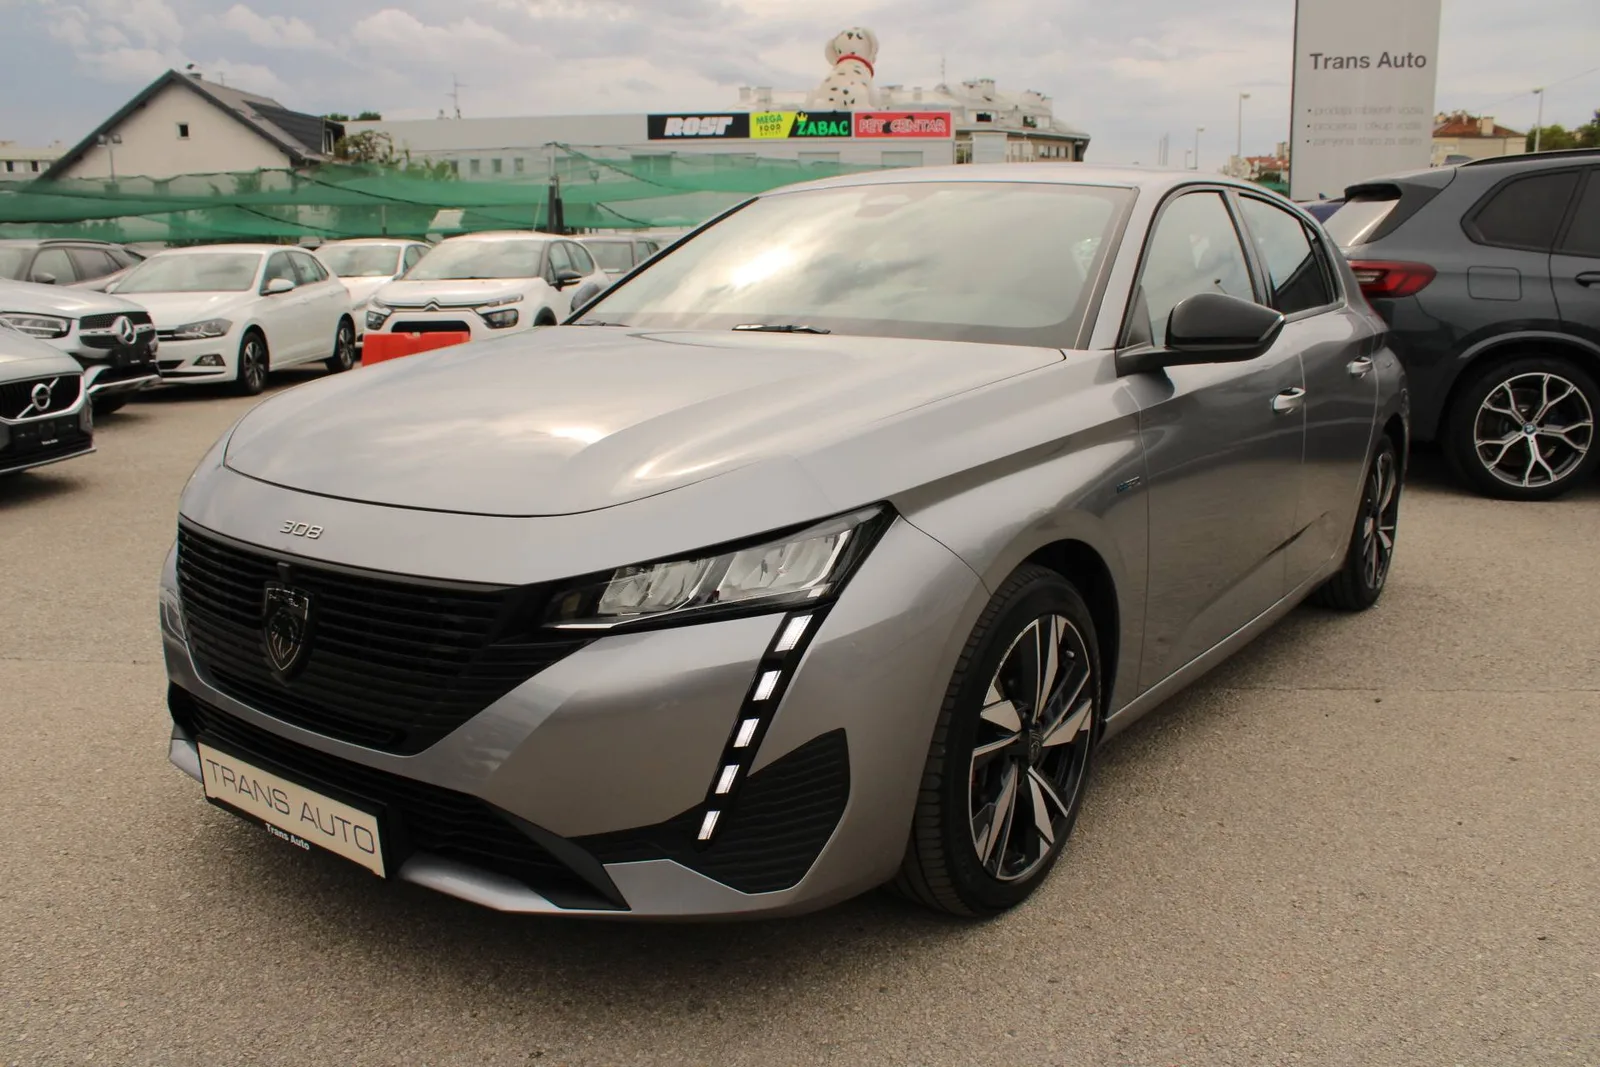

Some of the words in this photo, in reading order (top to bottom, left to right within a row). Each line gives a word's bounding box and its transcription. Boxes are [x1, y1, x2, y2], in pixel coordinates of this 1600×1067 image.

[1309, 52, 1370, 70] Trans
[1377, 51, 1427, 69] Auto
[664, 116, 733, 136] ROST
[756, 114, 783, 126] MEGA
[859, 118, 884, 133] PET
[890, 117, 946, 133] CENTAR
[279, 519, 324, 540] 308
[205, 758, 291, 816] TRANS
[299, 801, 376, 855] AUTO
[265, 822, 289, 841] Trans
[290, 834, 310, 851] Auto
